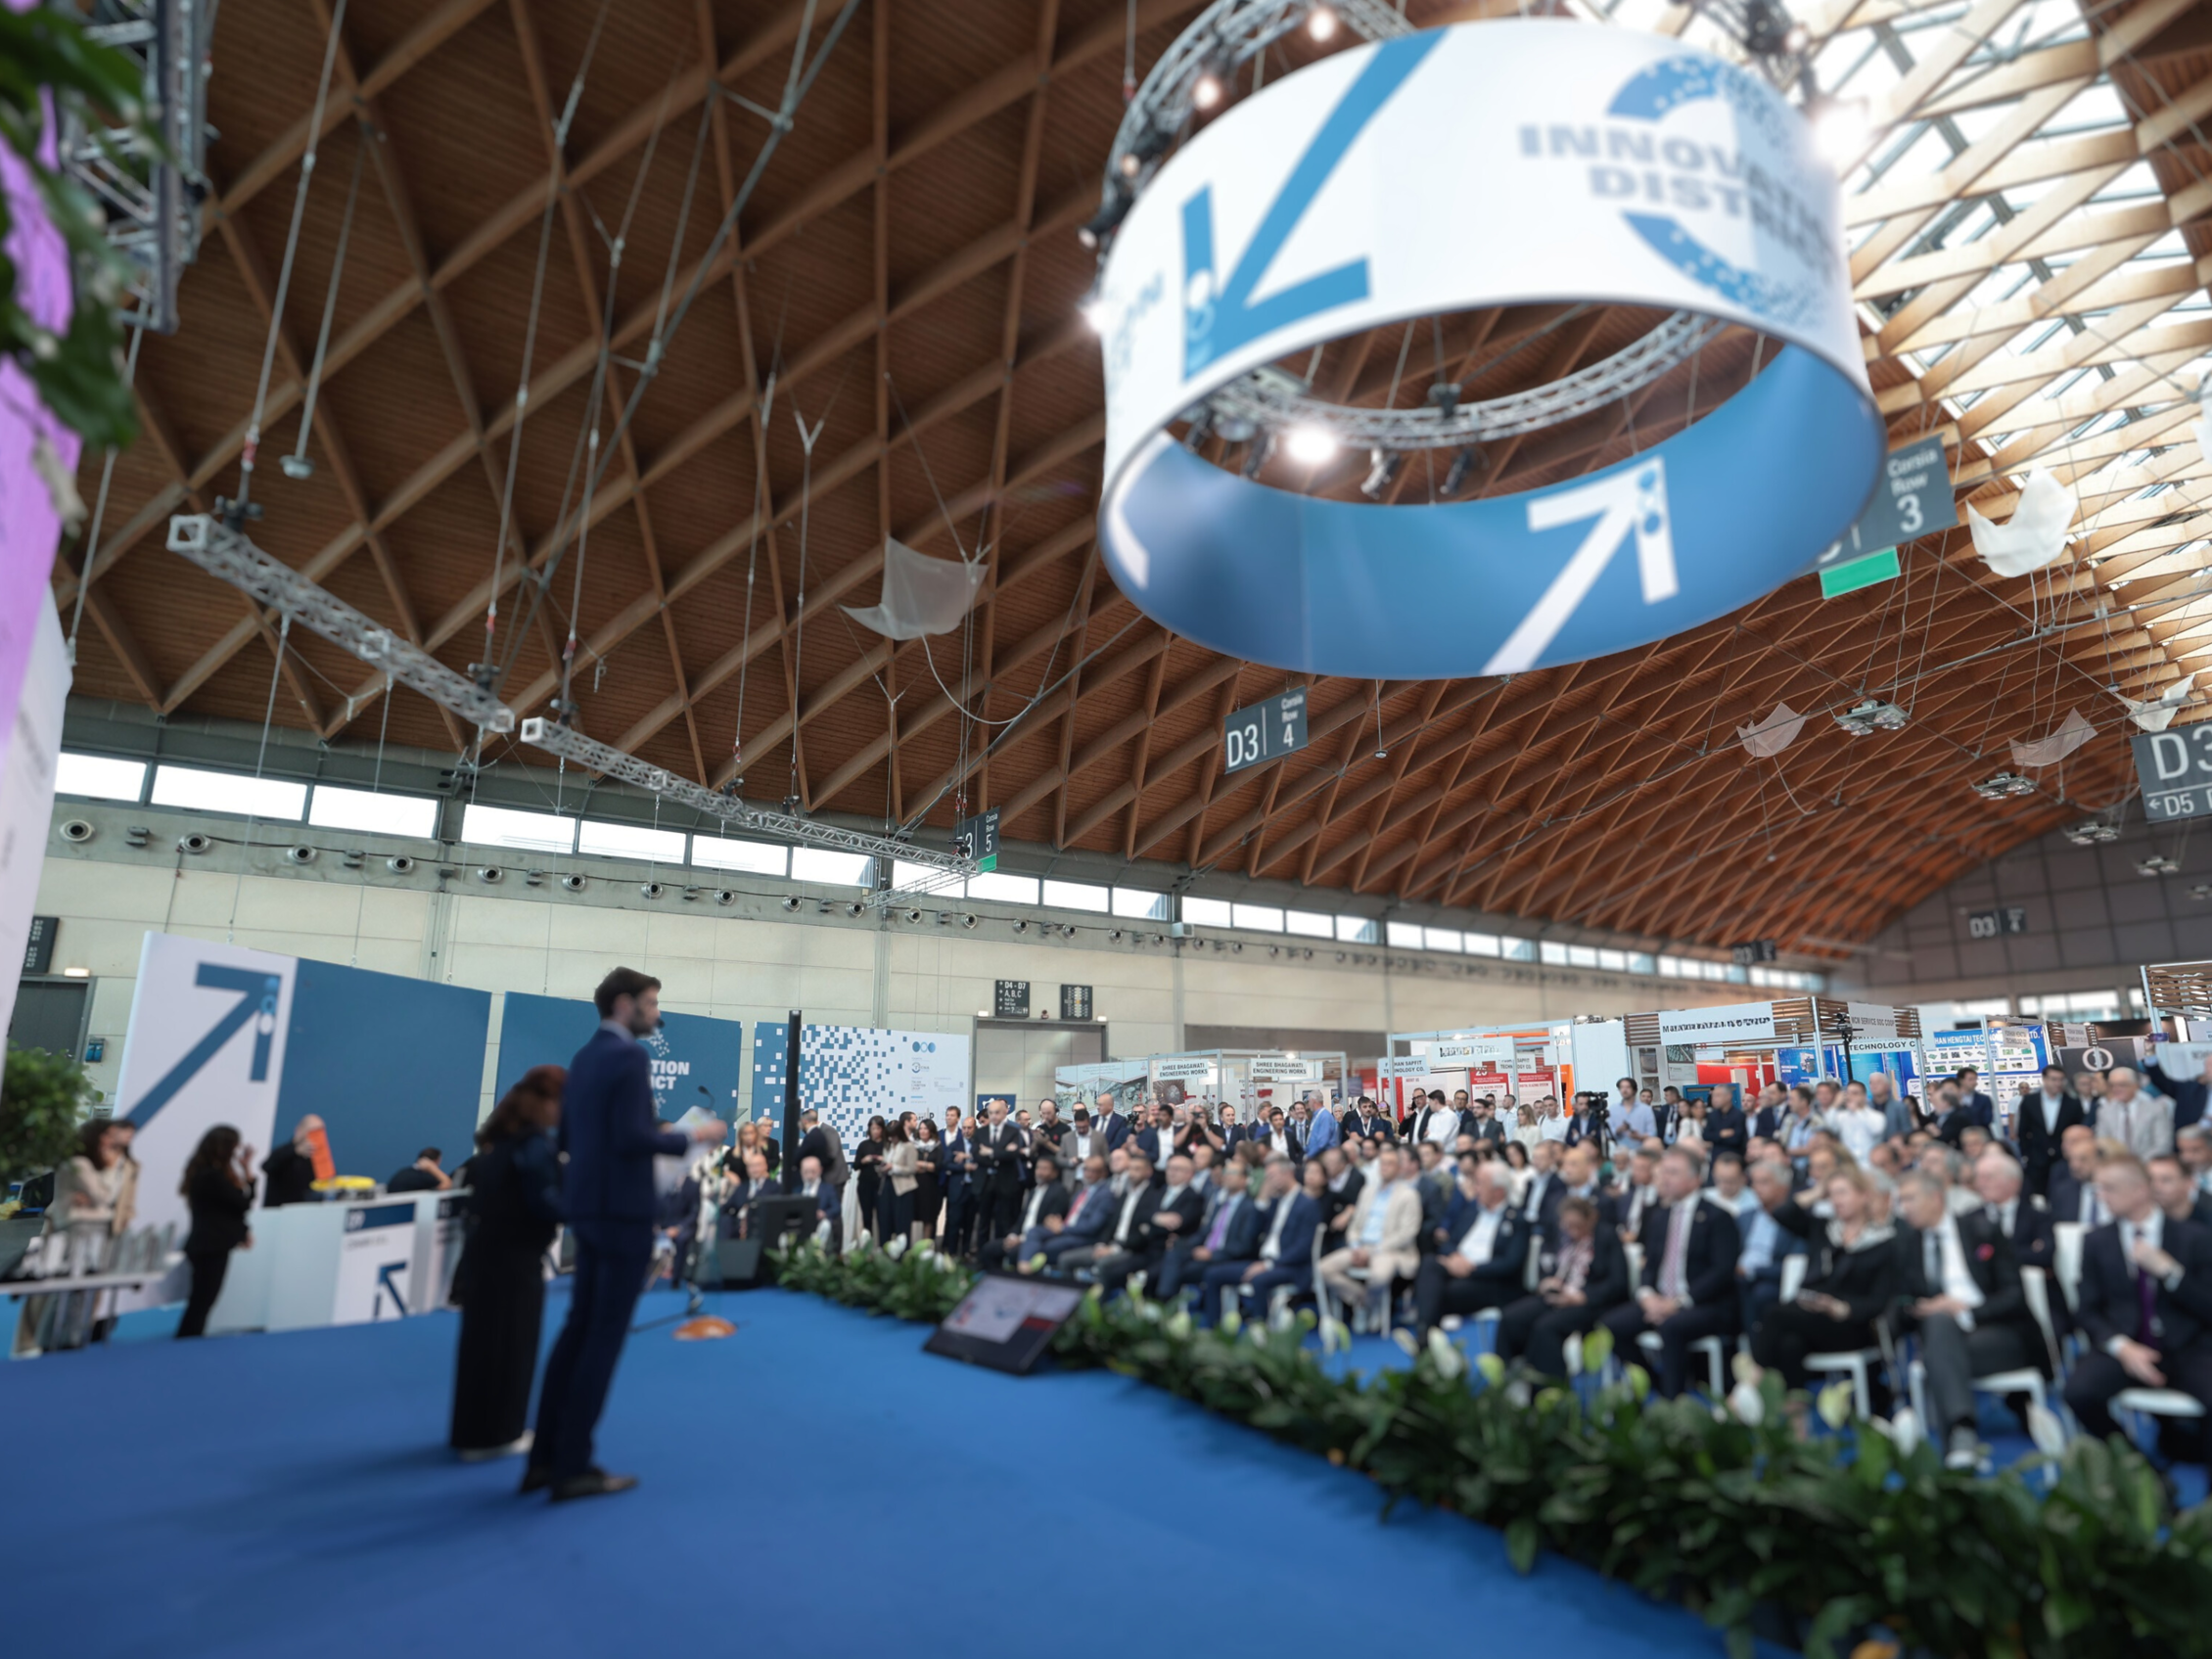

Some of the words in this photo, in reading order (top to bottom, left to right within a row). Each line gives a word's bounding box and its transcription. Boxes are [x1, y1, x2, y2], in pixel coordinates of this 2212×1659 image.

[1887, 448, 1938, 479] Corsia
[1890, 473, 1928, 497] Row
[1897, 493, 1924, 533] 3
[1281, 694, 1304, 711] Corsia
[1282, 710, 1299, 723] Row
[1227, 723, 1259, 767] D3
[1283, 723, 1294, 748] 4
[2150, 723, 2212, 780] D3
[2164, 793, 2194, 816] D5
[986, 812, 998, 823] Corsia
[986, 824, 994, 833] Row
[986, 834, 991, 853] 5
[1850, 1041, 1907, 1050] TECHNOLOGY
